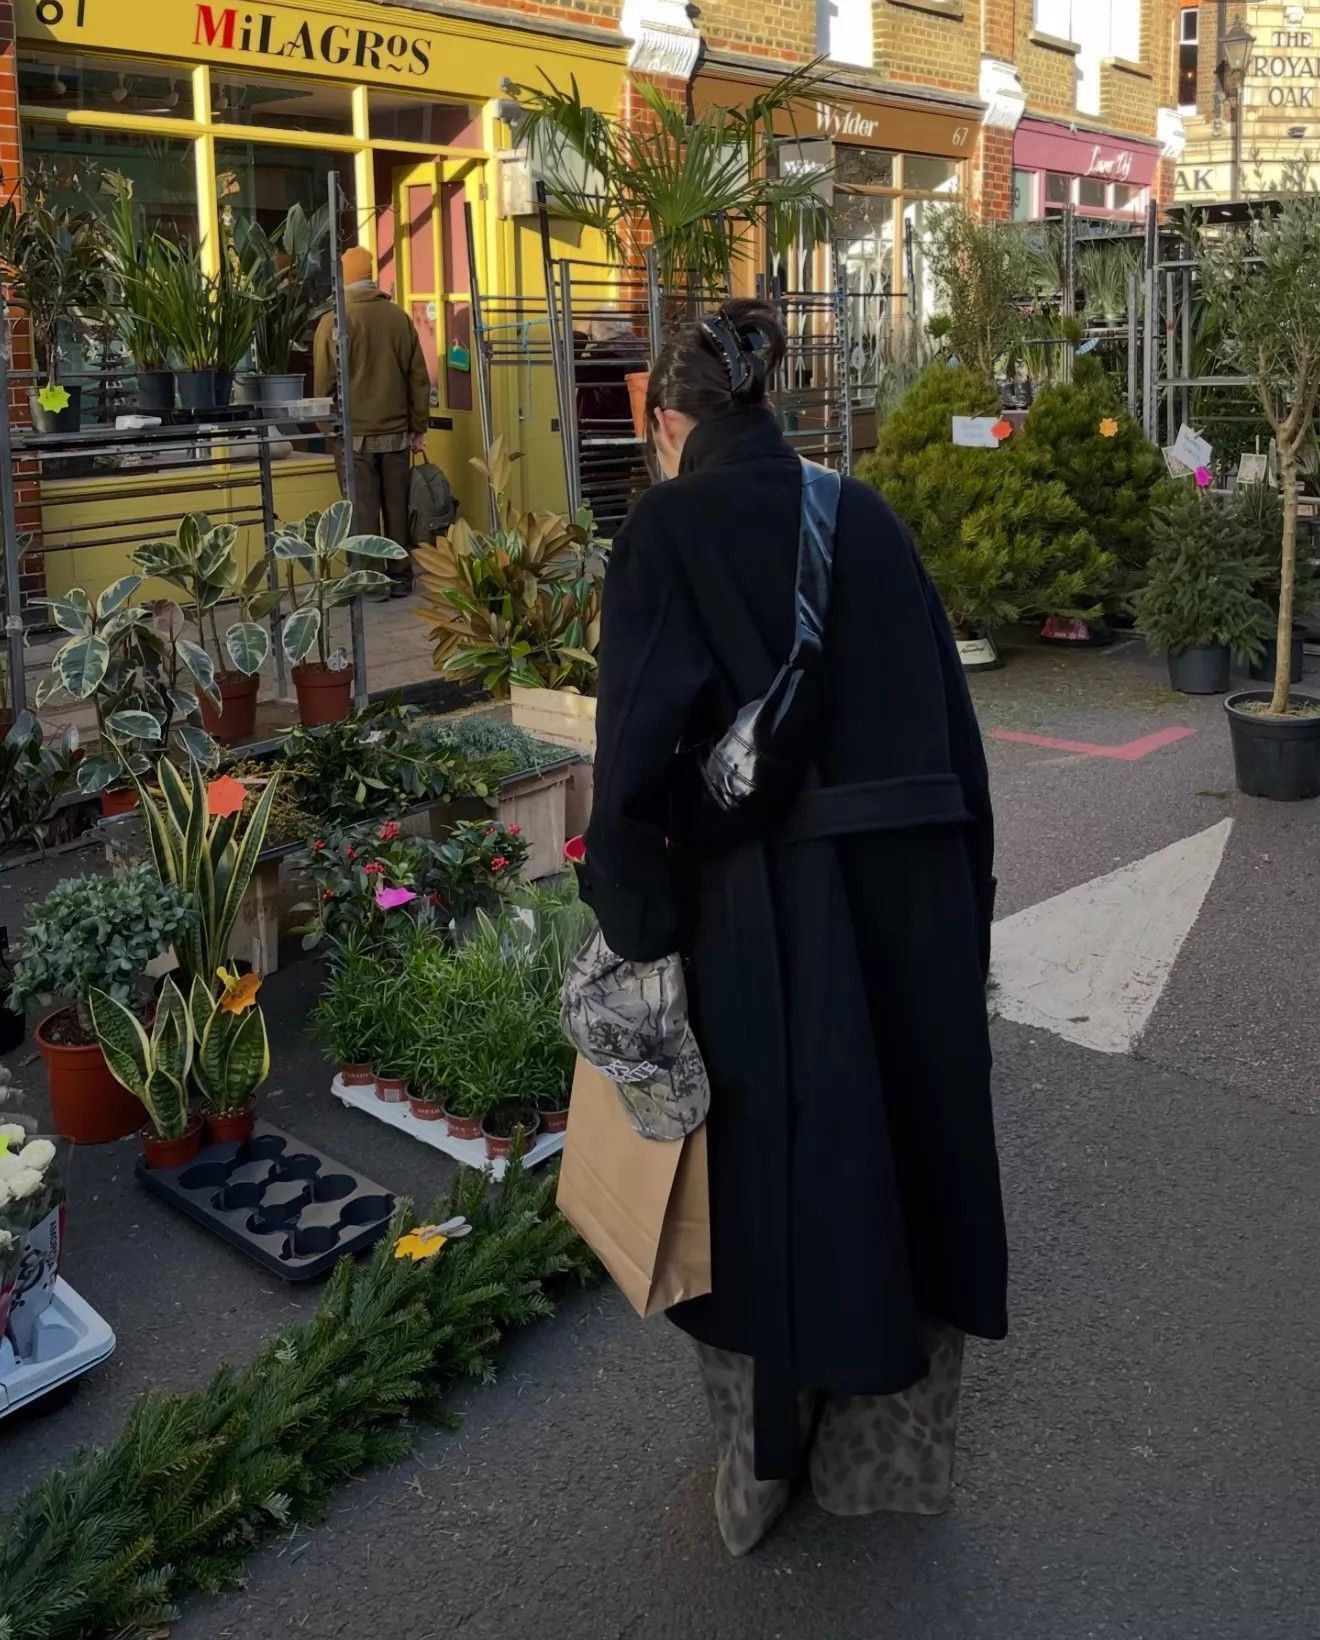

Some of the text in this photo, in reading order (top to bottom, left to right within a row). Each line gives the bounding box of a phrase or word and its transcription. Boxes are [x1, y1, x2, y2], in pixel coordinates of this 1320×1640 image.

[1272, 31, 1312, 48] THE
[1254, 56, 1320, 79] ROYA
[1268, 86, 1313, 107] OAK
[815, 101, 879, 139] Wylder
[951, 127, 969, 147] 67
